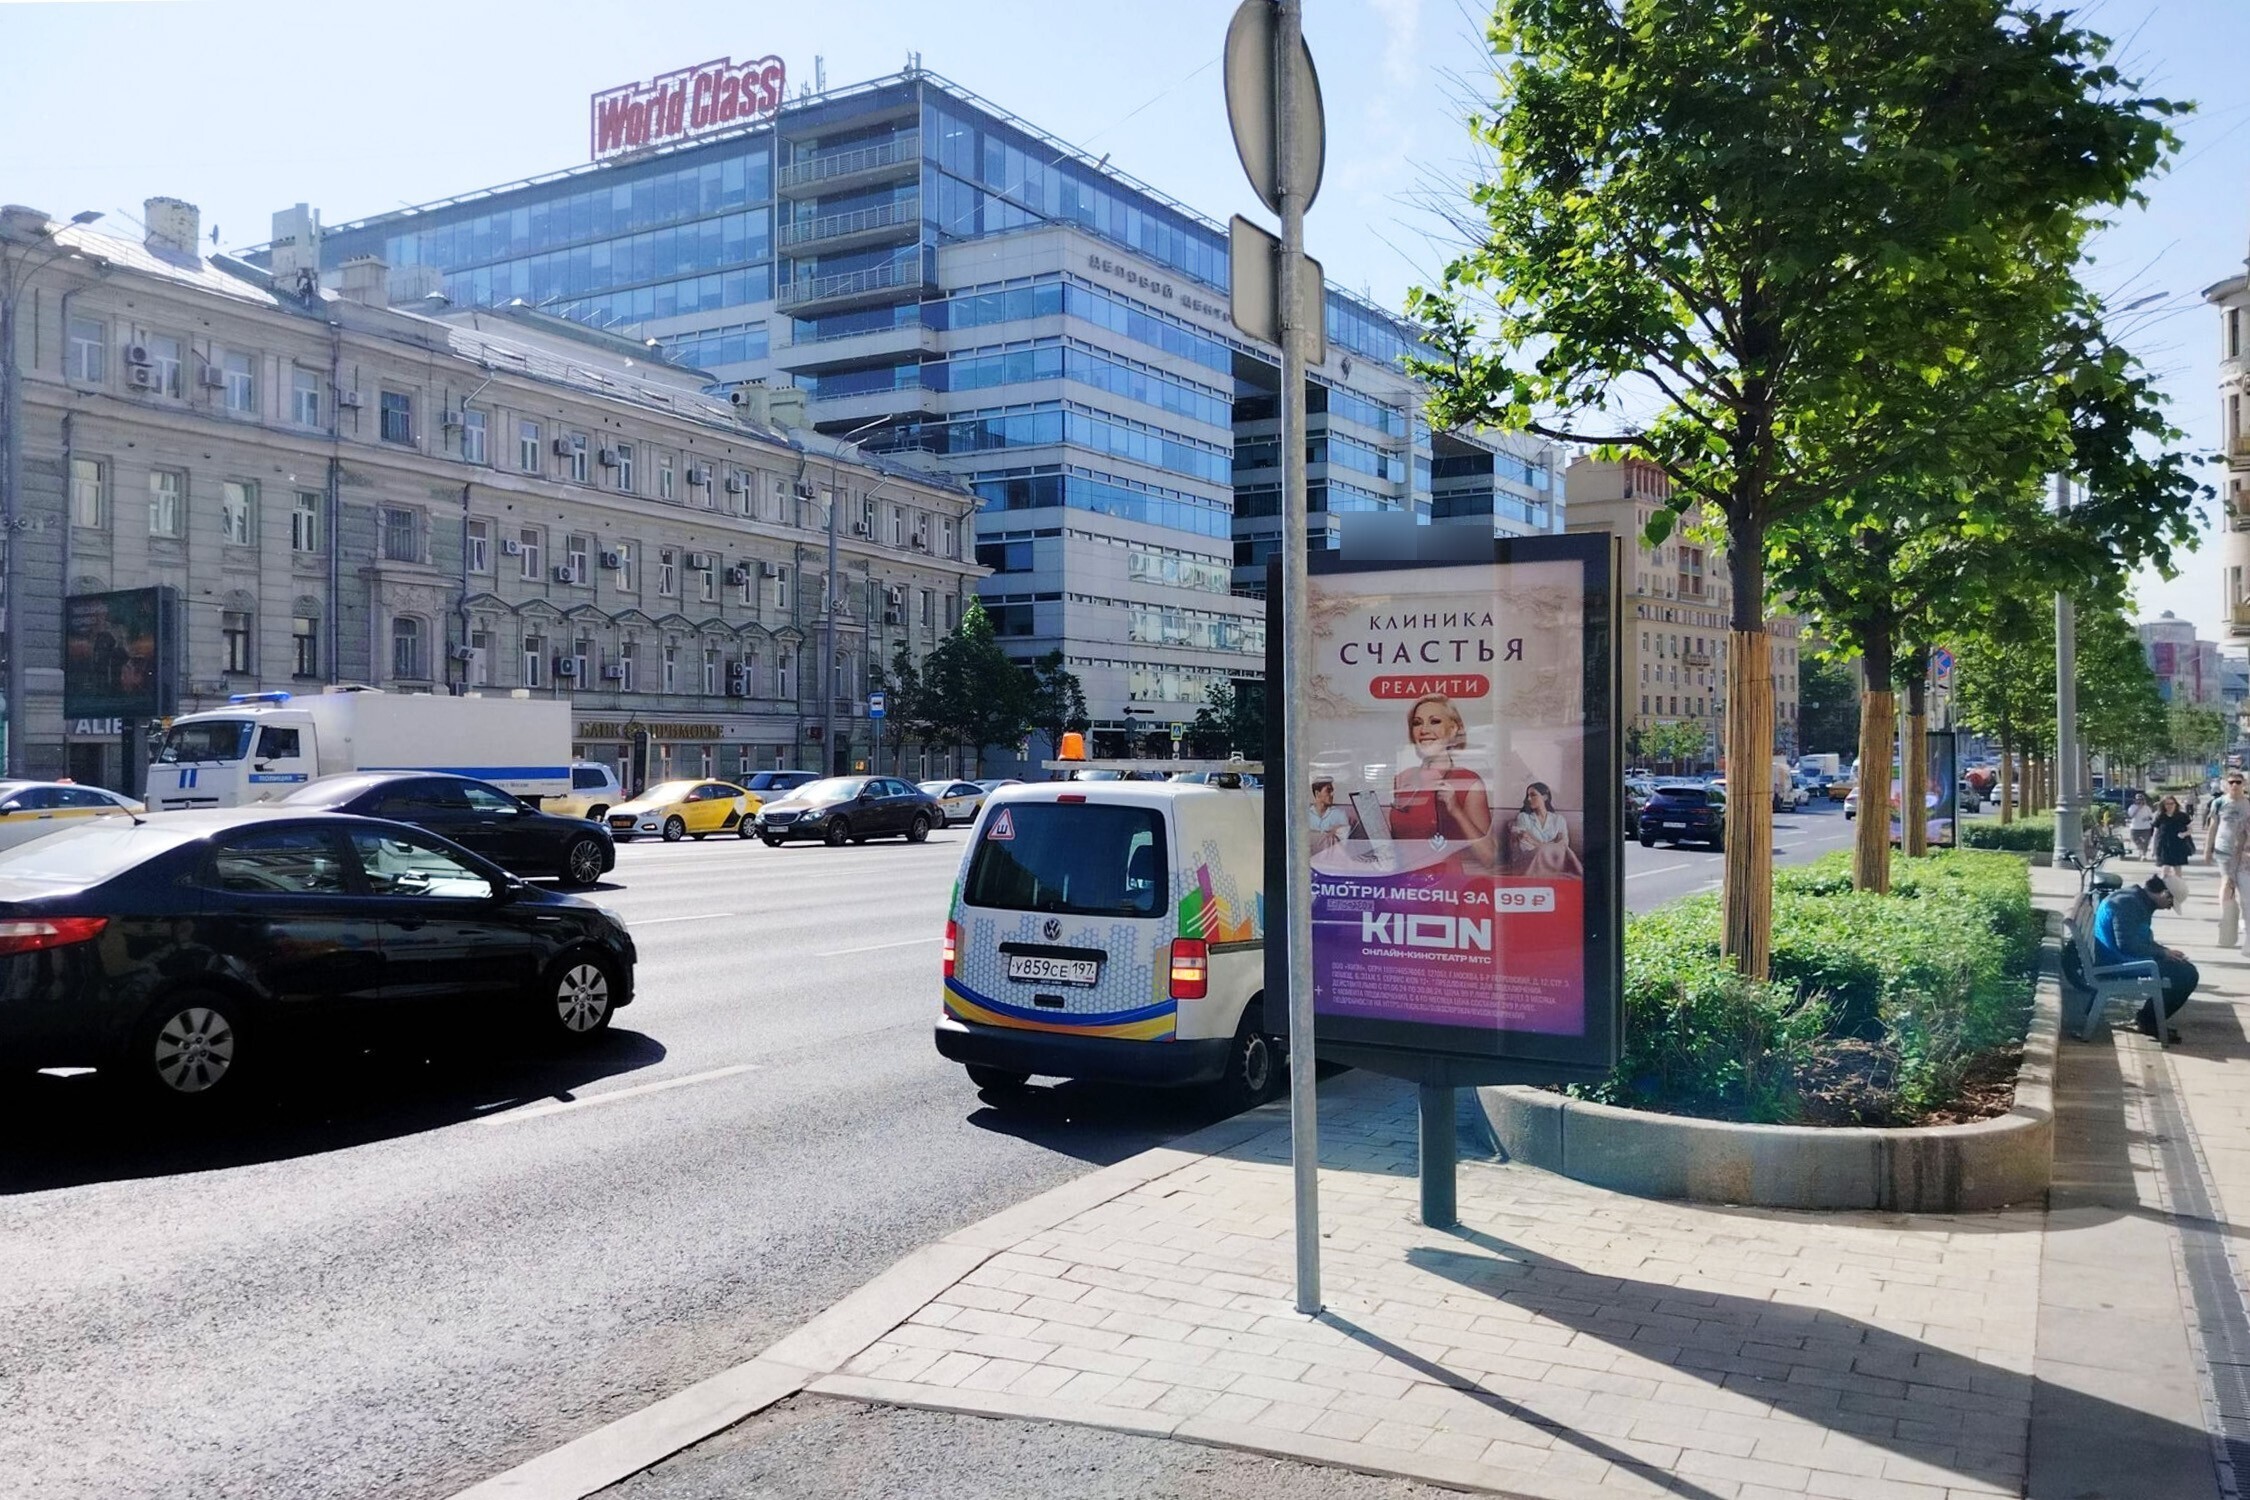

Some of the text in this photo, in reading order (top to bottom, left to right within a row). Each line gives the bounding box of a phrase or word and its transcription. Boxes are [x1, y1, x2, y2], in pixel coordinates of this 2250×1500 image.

[599, 66, 780, 152] World Class
[1088, 253, 1173, 299] ДЕЛОВОЙ
[1370, 611, 1494, 630] КЛИНИКА
[1340, 638, 1523, 665] СЧАСТЬЯ
[1381, 680, 1478, 694] РЕАЛИТИ
[259, 774, 293, 783] ПОЛИЦИЯ
[996, 824, 1008, 835] Ш
[1310, 883, 1385, 899] СМОТРИ
[1391, 888, 1459, 905] МЕСЯЦ
[1463, 891, 1490, 905] ЗА
[1500, 893, 1526, 906] 99
[1362, 911, 1492, 952] KION
[1362, 948, 1492, 964] ОНЛАЙН-КИНОТЕАТР МТС
